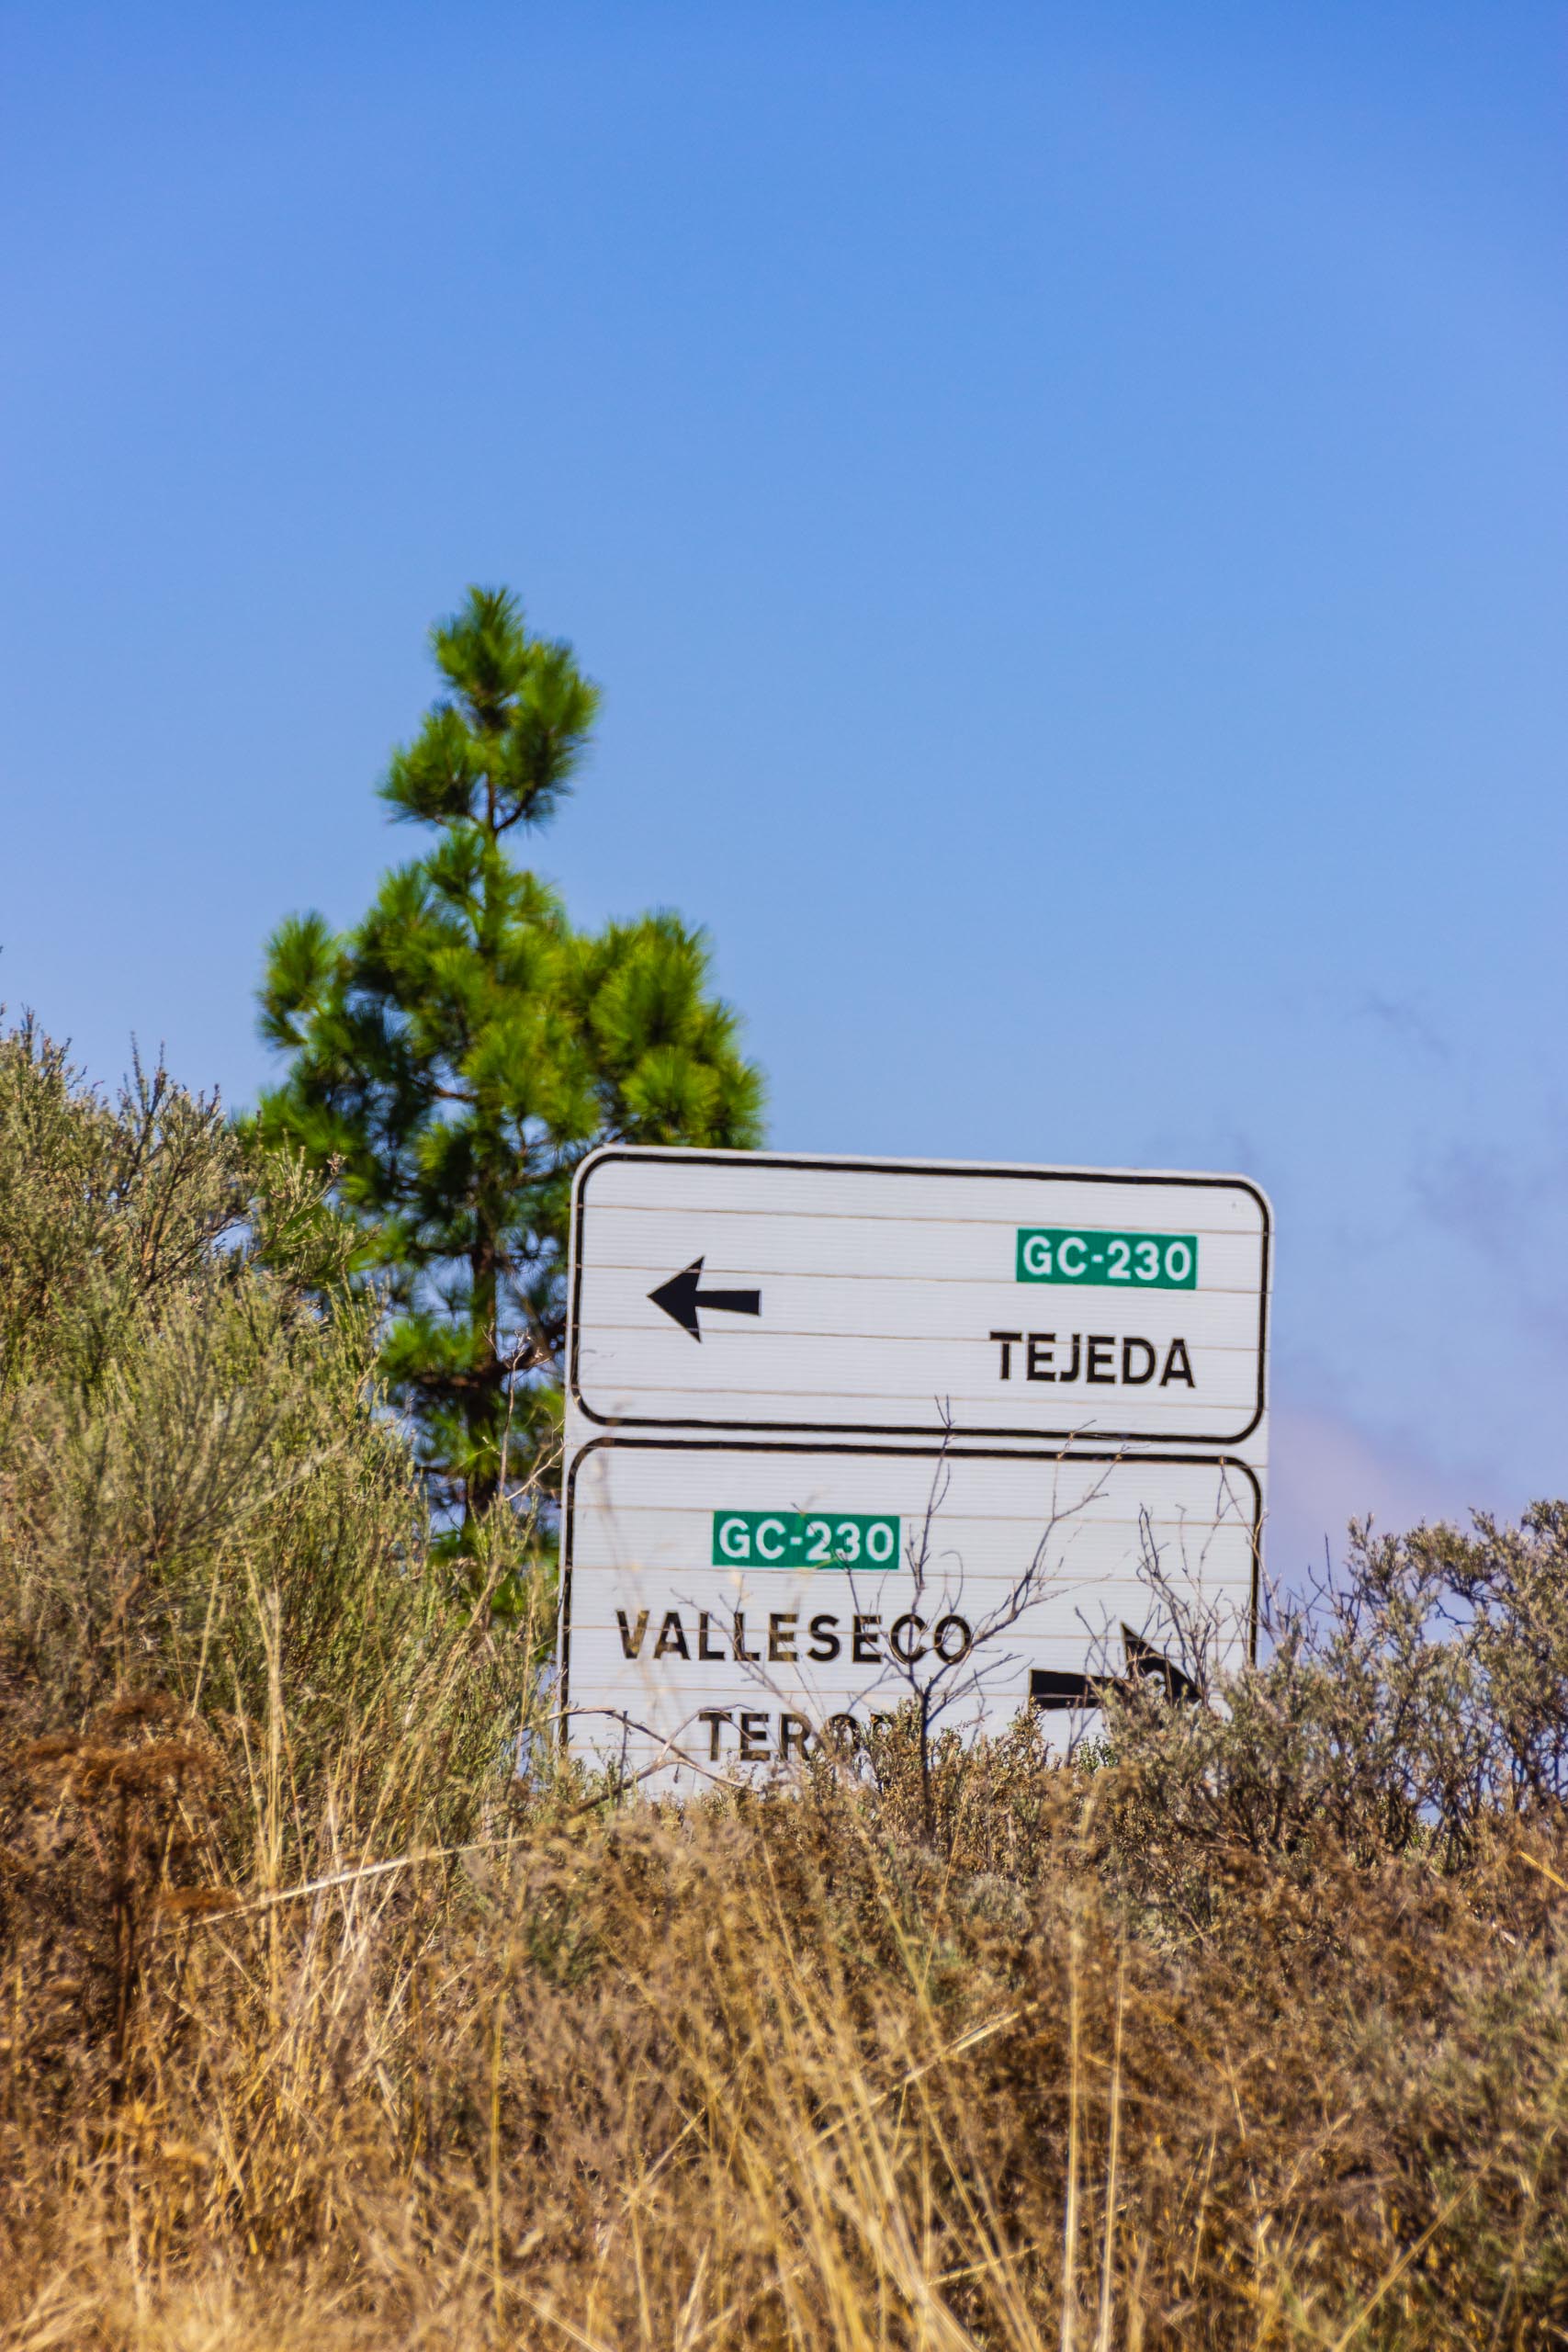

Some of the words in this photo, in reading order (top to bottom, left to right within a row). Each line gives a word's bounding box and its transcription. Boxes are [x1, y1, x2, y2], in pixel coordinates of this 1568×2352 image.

[1022, 1236, 1191, 1282] GC-230
[989, 1330, 1196, 1388] TEJEDA
[718, 1518, 896, 1562] GC-230
[615, 1610, 974, 1665] VALLESECO
[698, 1711, 895, 1763] TERO
